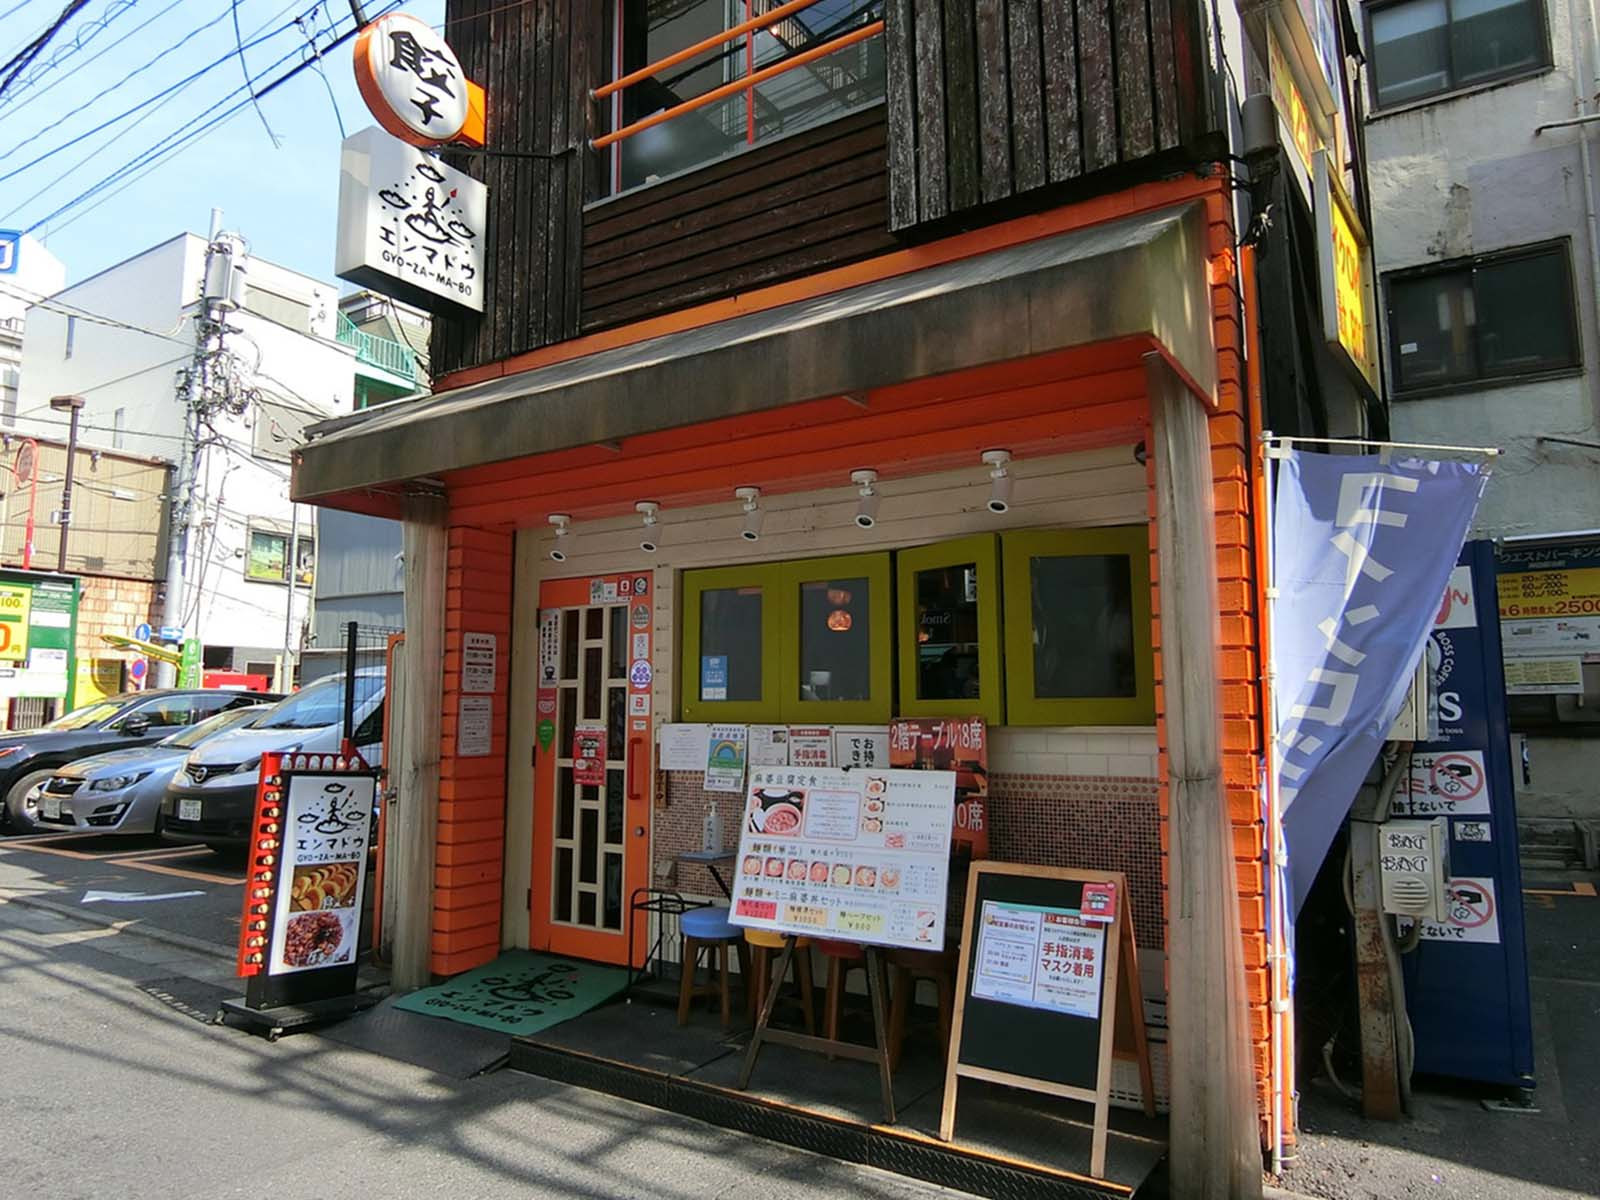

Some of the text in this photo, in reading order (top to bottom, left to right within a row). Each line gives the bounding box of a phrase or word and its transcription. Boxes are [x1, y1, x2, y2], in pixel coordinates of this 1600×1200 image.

[379, 226, 475, 280] エンマドウ
[953, 802, 983, 831] 0席
[297, 838, 364, 851] エンマドウ
[1042, 942, 1095, 962] 手指消毒
[1041, 958, 1095, 978] マスク着用
